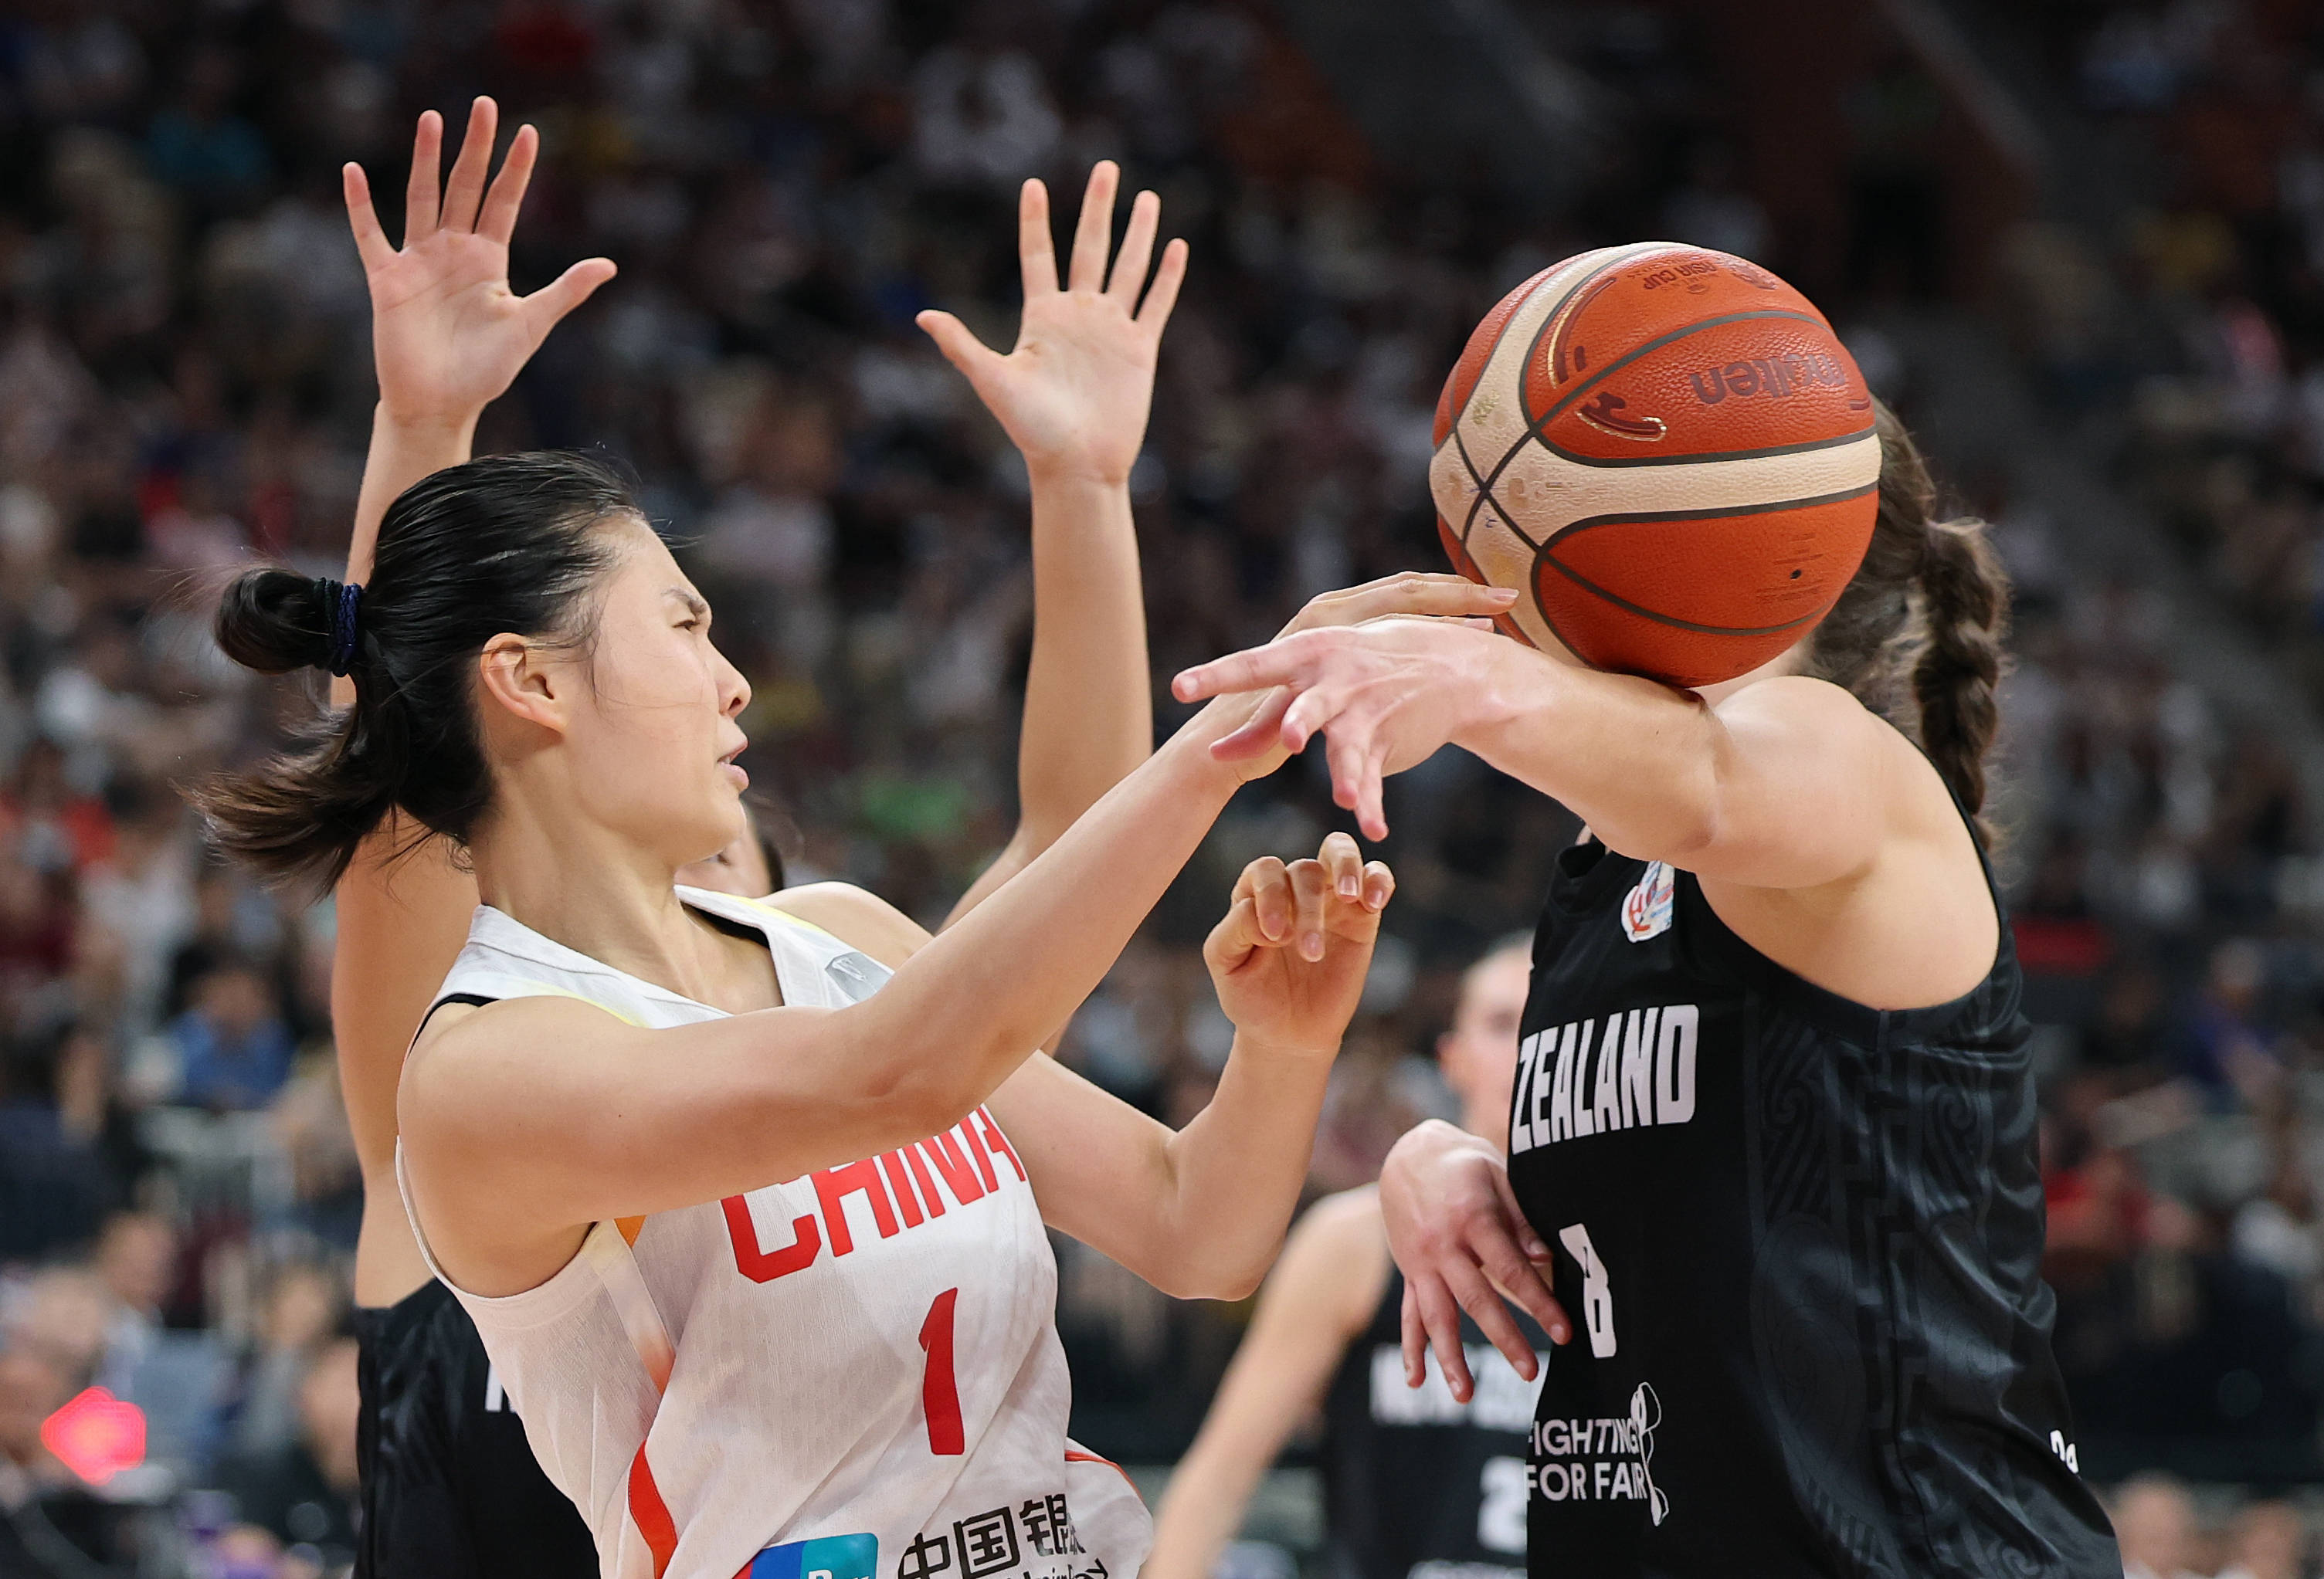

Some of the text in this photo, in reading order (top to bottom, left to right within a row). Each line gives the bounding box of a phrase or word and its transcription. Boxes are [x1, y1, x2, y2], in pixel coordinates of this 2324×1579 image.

[1644, 269, 1677, 290] CUP
[1674, 261, 1718, 277] ASIA
[1689, 354, 1846, 405] molten
[1511, 1004, 1700, 1156] ZEALAND
[721, 1106, 1026, 1284] CHINA
[918, 1287, 965, 1455] 1
[1528, 1418, 1640, 1456] IGHTING
[1526, 1462, 1587, 1502] FOR
